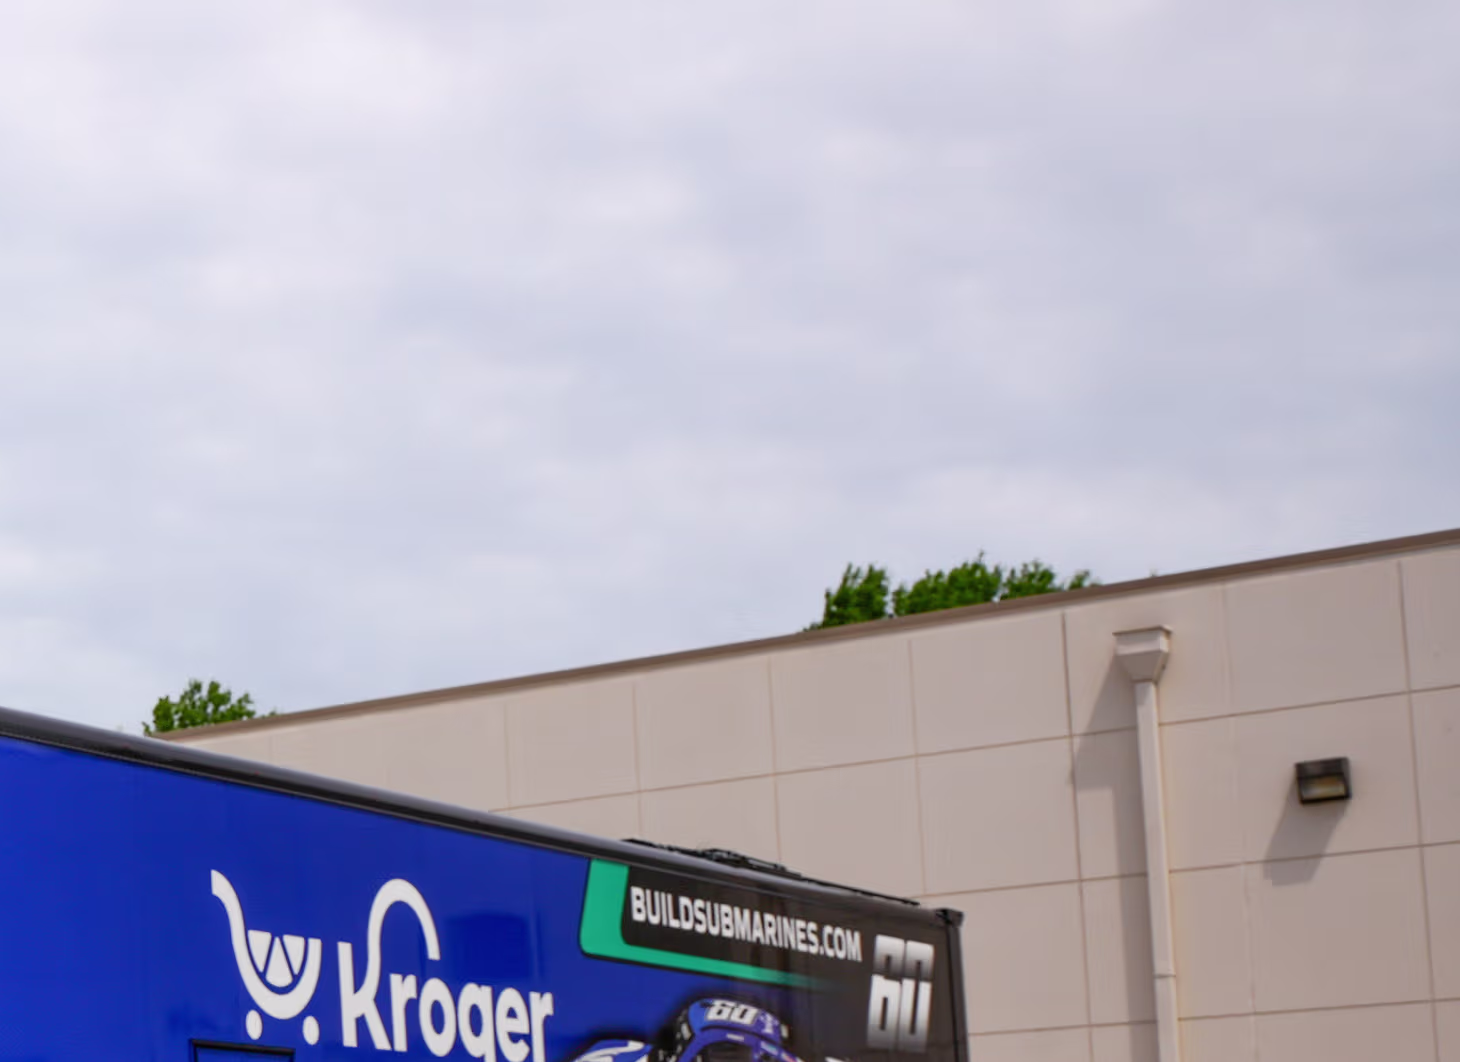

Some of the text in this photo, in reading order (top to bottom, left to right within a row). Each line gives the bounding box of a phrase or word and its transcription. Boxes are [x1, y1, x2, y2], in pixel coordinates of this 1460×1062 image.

[630, 886, 862, 962] BUILDSUBMARINES.COM
[706, 999, 760, 1026] 60
[866, 934, 934, 1053] 60
